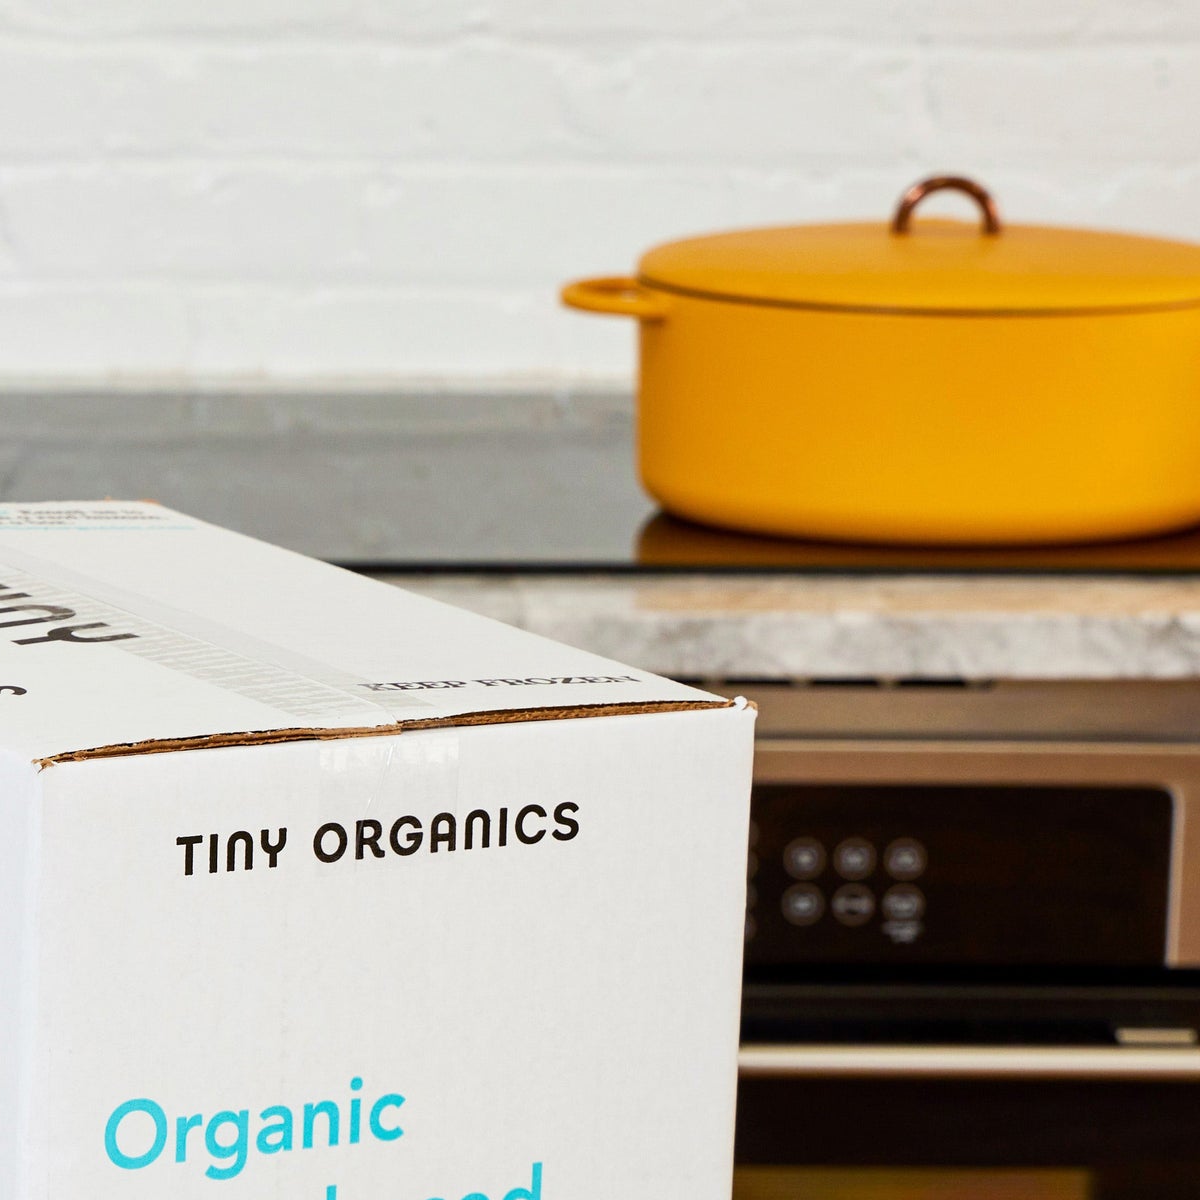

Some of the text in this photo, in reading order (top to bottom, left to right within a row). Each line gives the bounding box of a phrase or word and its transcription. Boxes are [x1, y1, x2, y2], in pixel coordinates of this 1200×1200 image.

[357, 676, 642, 691] KEEP FROZEN
[175, 800, 581, 878] TINY ORGANICS
[103, 1076, 406, 1181] Organic
